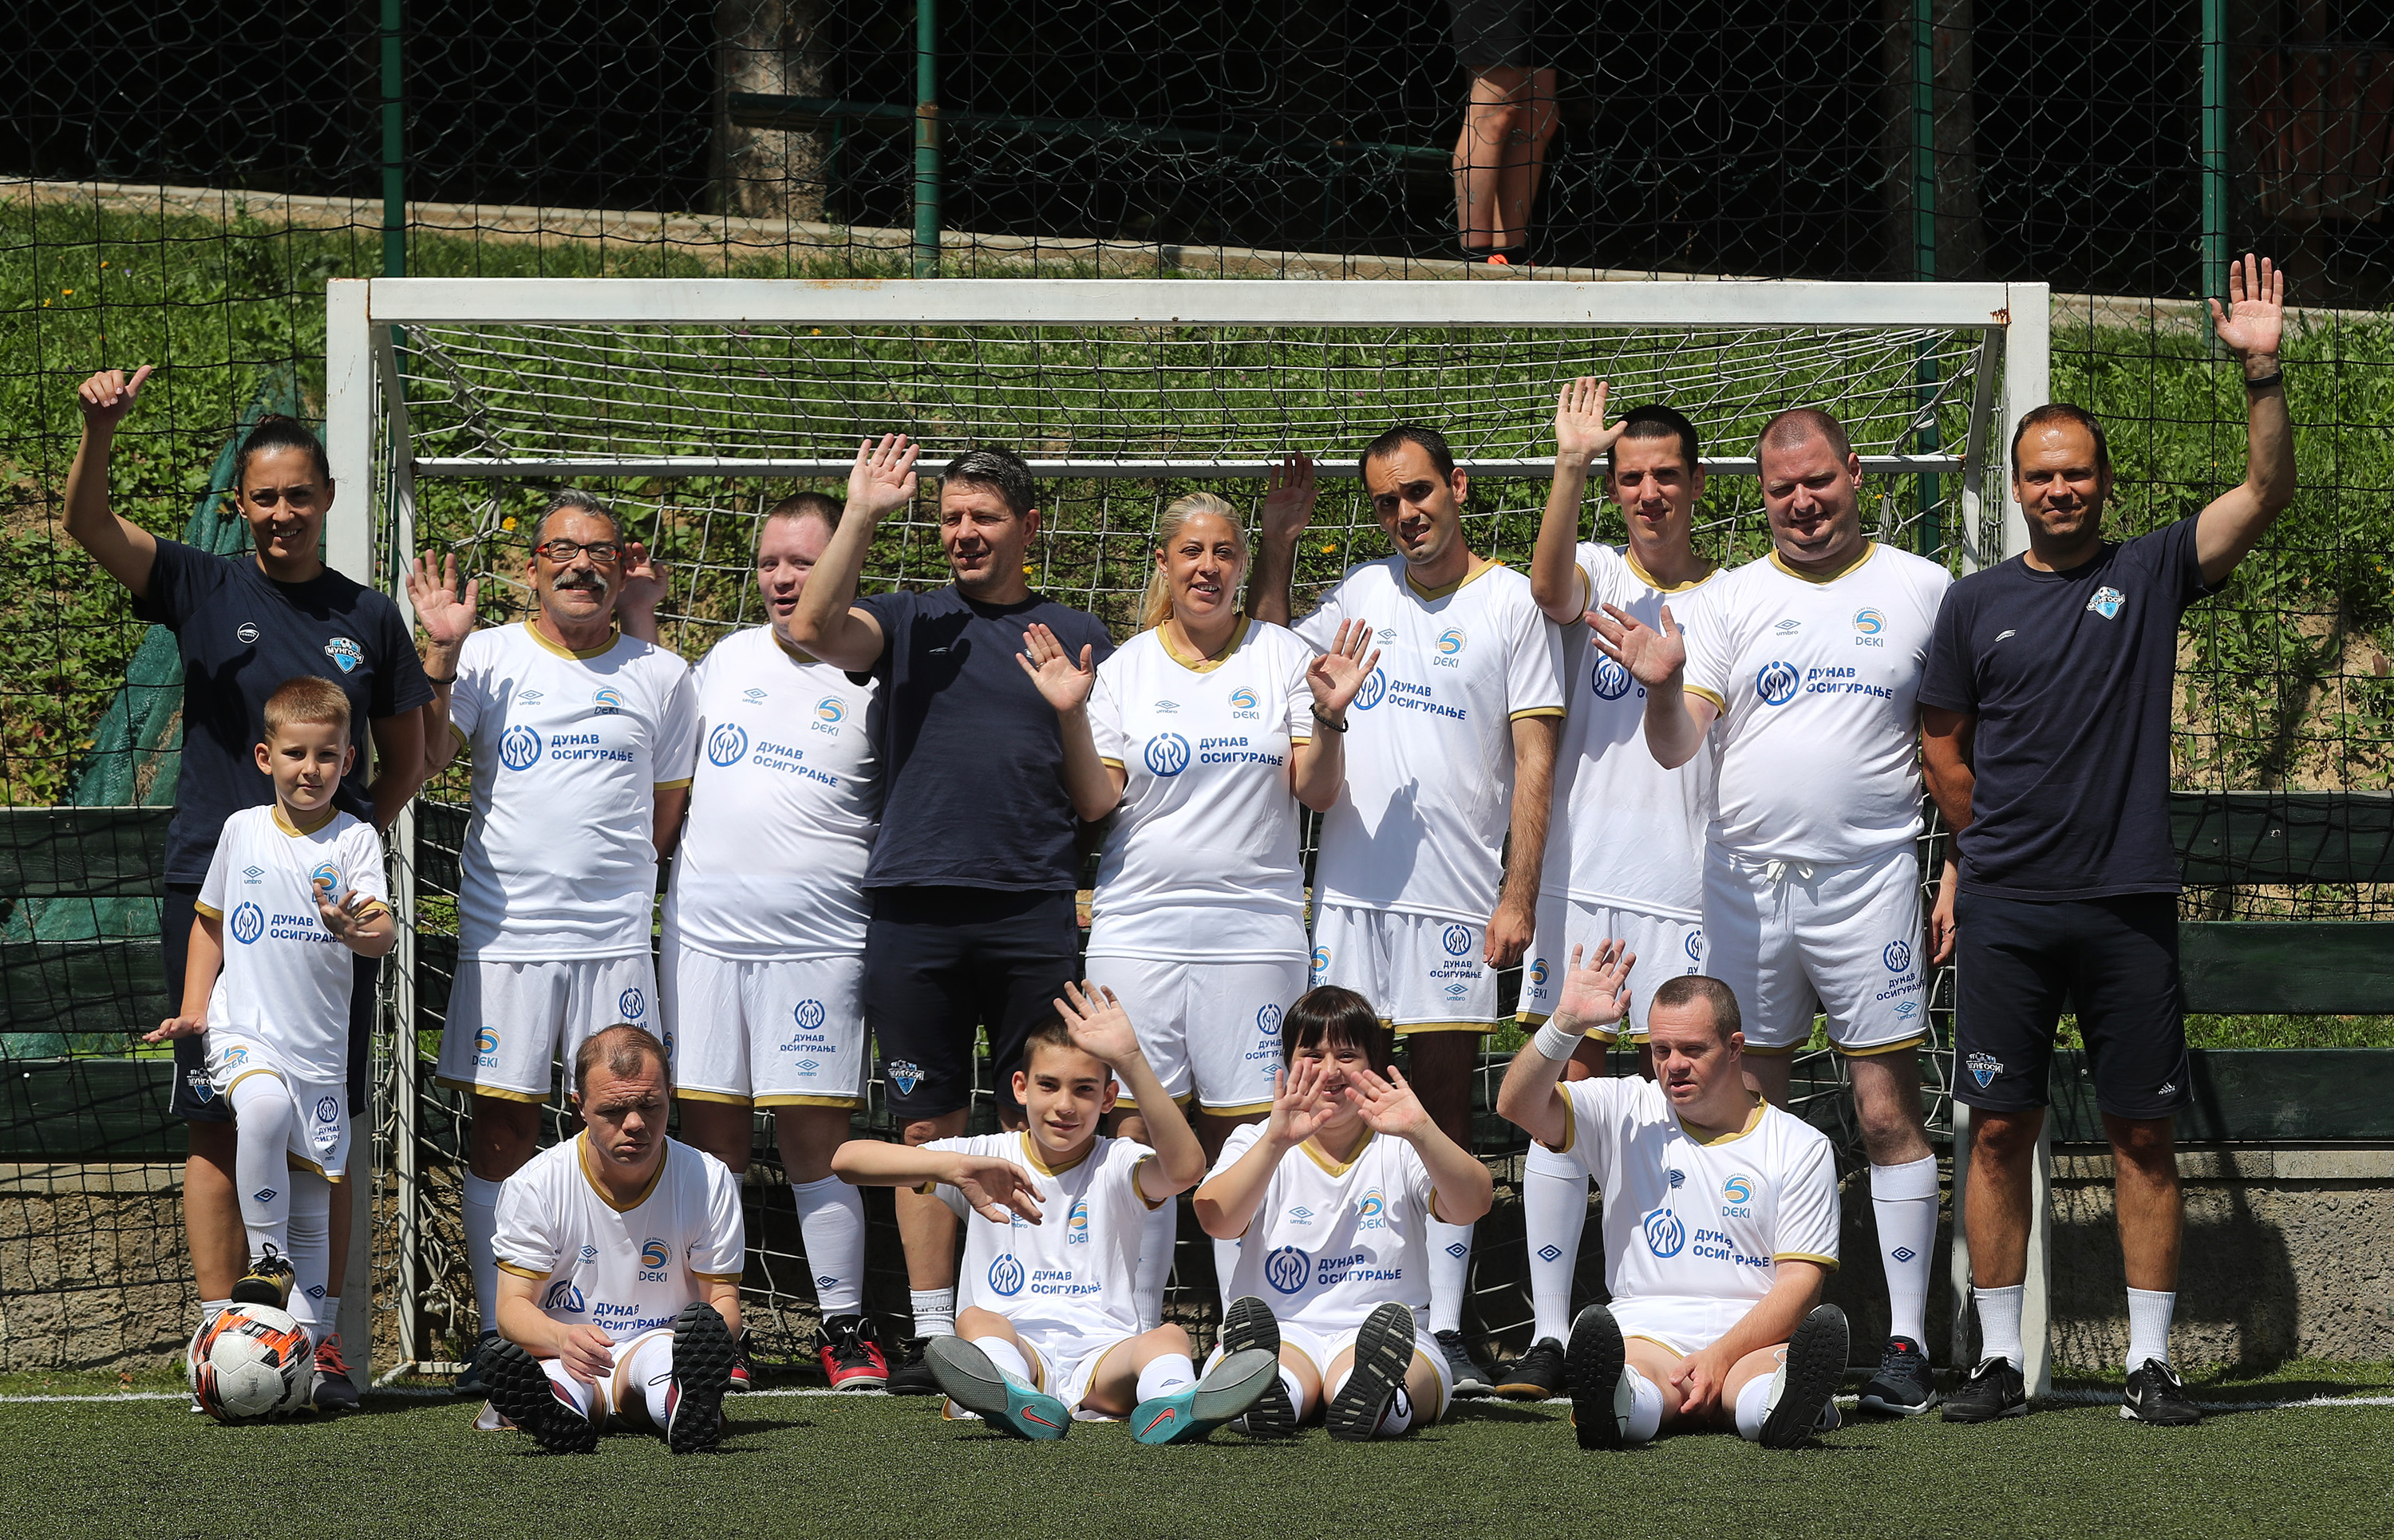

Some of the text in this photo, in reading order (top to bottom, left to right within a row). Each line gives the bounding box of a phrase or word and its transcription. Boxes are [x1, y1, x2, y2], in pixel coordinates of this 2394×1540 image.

[2088, 596, 2124, 610] МУНГОСИ
[1855, 636, 1883, 648] DEKI
[326, 646, 362, 661] МУНГОСИ
[1433, 656, 1460, 669] DEKI
[1807, 667, 1856, 682] ДУНАВ
[1389, 679, 1432, 697] ДУНАВ
[1806, 682, 1894, 700] ОСИГУРАЊЕ
[1389, 693, 1467, 720] ОСИГУРАЊЕ
[1233, 711, 1259, 720] DEKI
[811, 721, 839, 737] DEKI
[551, 734, 599, 748] ДУНАВ
[1199, 736, 1249, 750] ДУНАВ
[551, 749, 634, 763] ОСИГУРАЊЕ
[756, 741, 804, 760] ДУНАВ
[1200, 752, 1283, 767] ОСИГУРАЊЕ
[753, 755, 839, 788] ОСИГУРАЊЕ
[271, 914, 314, 927] ДУНАВ
[1444, 961, 1472, 969] ДУНАВ
[1311, 974, 1327, 986] EKI
[1889, 973, 1916, 989] ДУНАВ
[1527, 986, 1547, 1000] DEKI
[1897, 1013, 1917, 1021] umbro
[793, 1034, 824, 1043] ДУНАВ
[226, 1056, 249, 1076] DEKI
[472, 1056, 498, 1068] DEKI
[1722, 1206, 1751, 1218] DEKI
[1358, 1218, 1386, 1231] DEKI
[1317, 1254, 1365, 1272] ДУНАВ
[638, 1270, 667, 1283] DEKI
[1032, 1270, 1073, 1281] ДУНАВ
[1317, 1269, 1403, 1285] ОСИГУРАЊЕ
[593, 1301, 640, 1317] ДУНАВ
